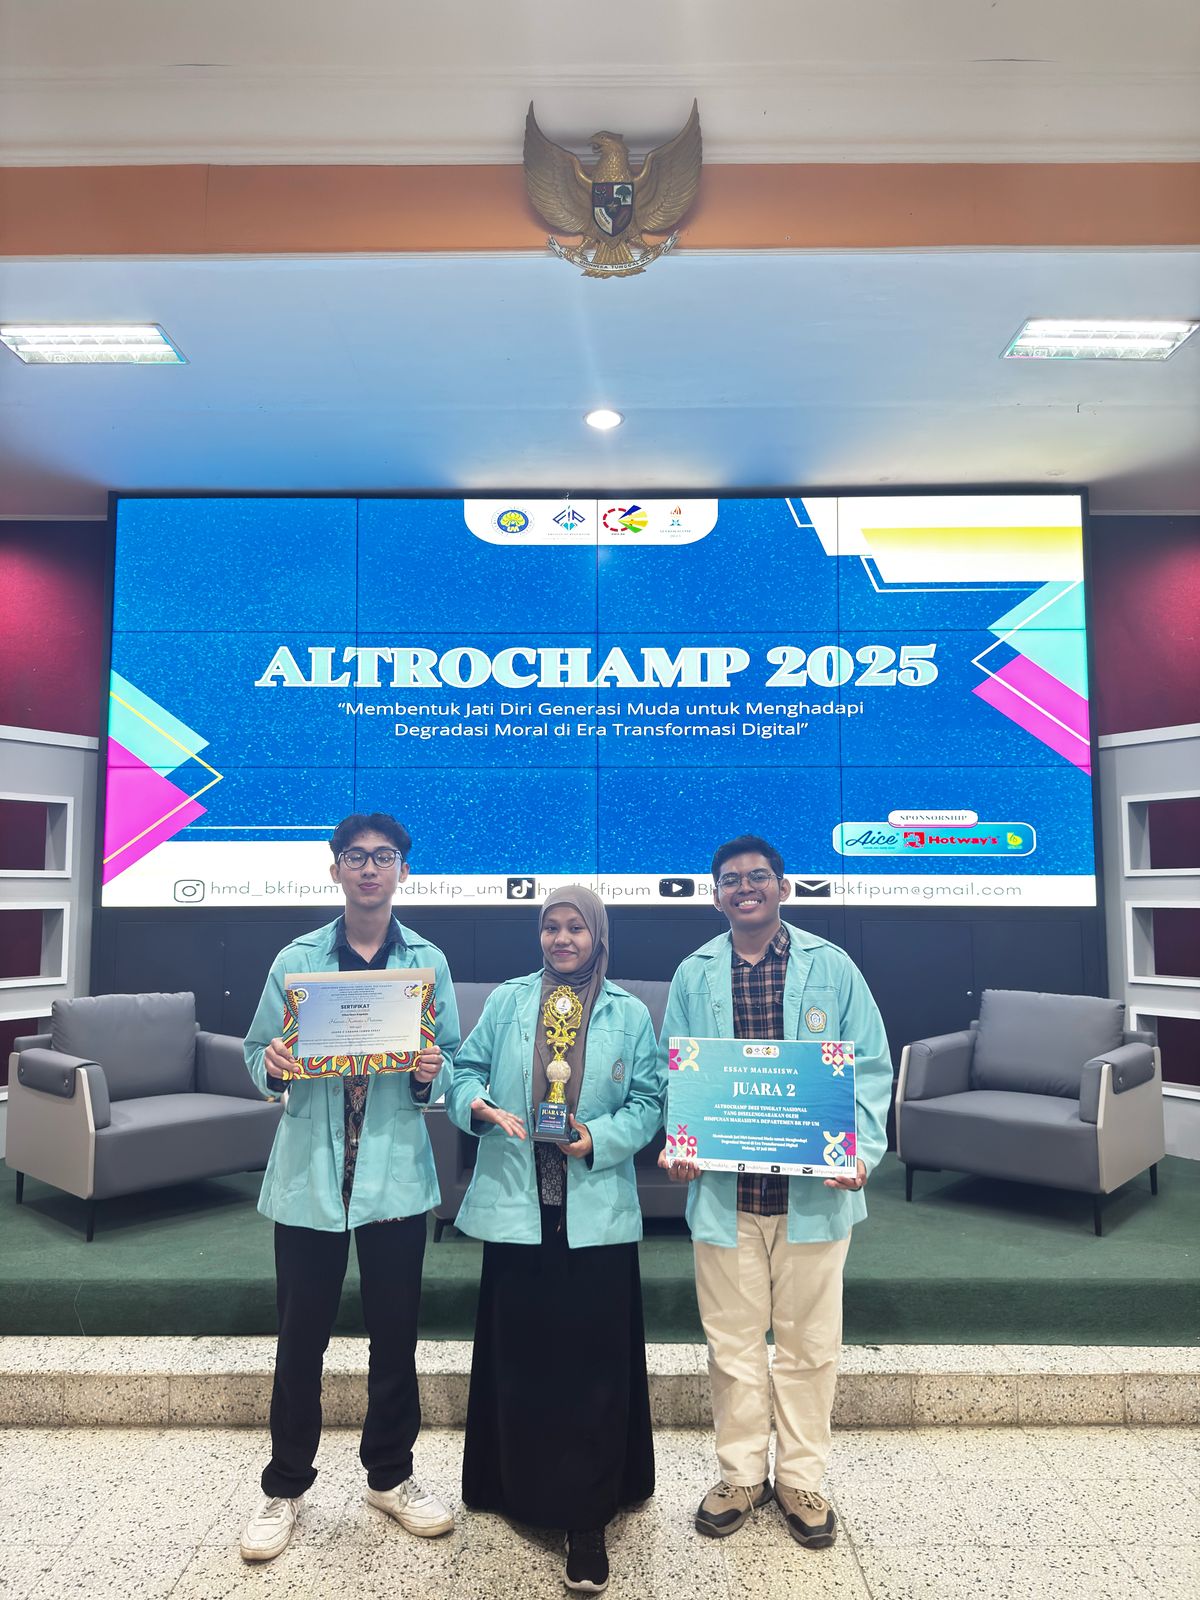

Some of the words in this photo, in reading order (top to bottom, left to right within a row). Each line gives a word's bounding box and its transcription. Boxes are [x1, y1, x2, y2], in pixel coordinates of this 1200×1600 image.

[254, 646, 751, 689] ALTROCHAMP
[765, 643, 939, 687] 2025
[337, 702, 461, 716] “Membentuk
[464, 702, 494, 718] Jati
[501, 702, 532, 716] Diri
[538, 702, 621, 716] Generasi
[627, 702, 680, 716] Muda
[686, 701, 740, 716] untuk
[745, 701, 865, 718] Menghadapi
[395, 723, 489, 740] Degradasi
[494, 723, 548, 737] Moral
[554, 723, 570, 737] di
[577, 723, 607, 737] Era
[612, 722, 736, 737] Transformasi
[742, 722, 809, 739] Digital”
[845, 830, 900, 847] Aice
[928, 835, 999, 847] Hotway's
[210, 881, 339, 898] hmd_bkfipum
[833, 882, 1022, 899] bkfipum@gmail.com
[750, 1067, 798, 1075] MAHASISWA
[732, 1081, 783, 1098] JUARA
[786, 1083, 796, 1097] 2
